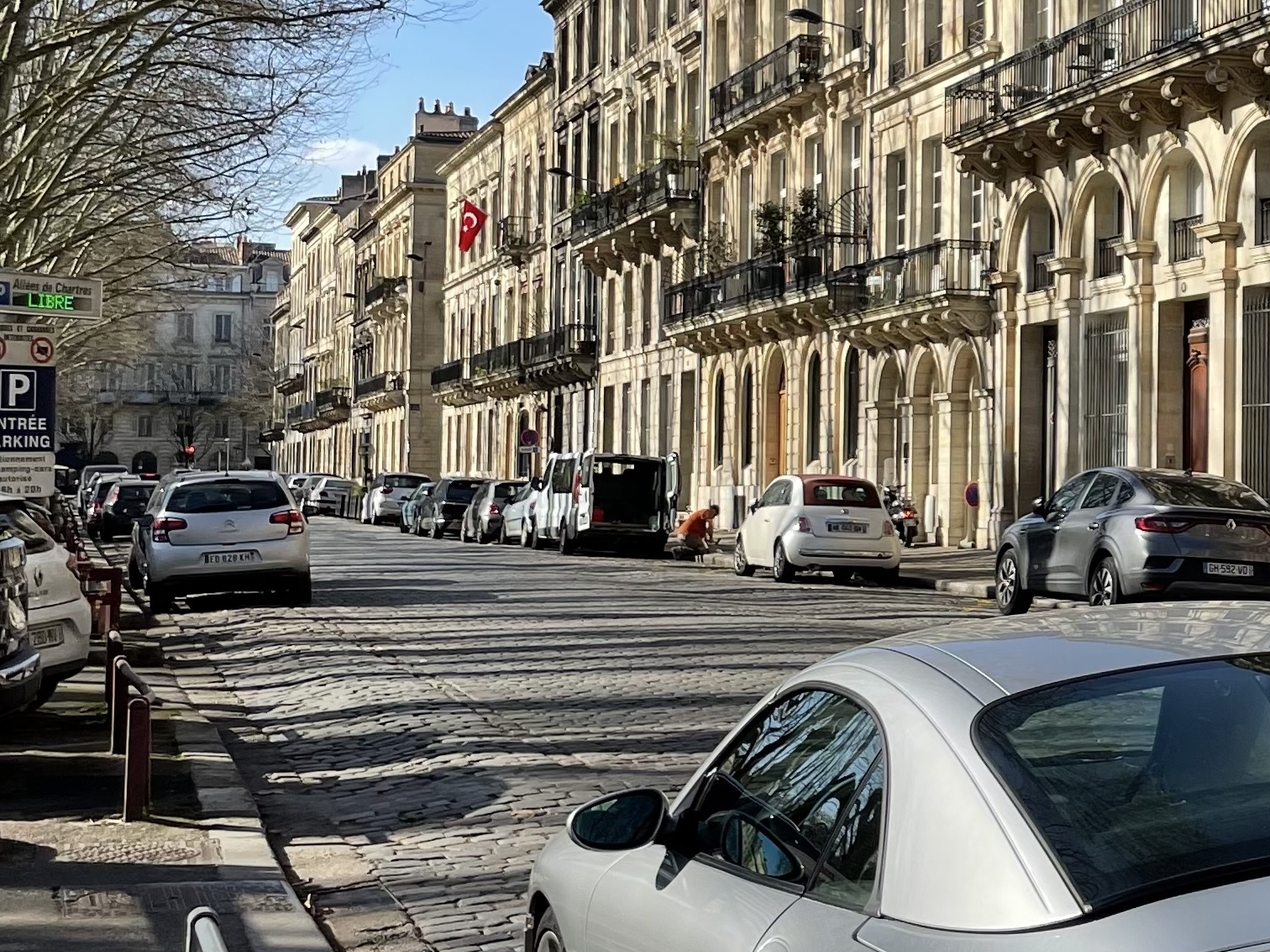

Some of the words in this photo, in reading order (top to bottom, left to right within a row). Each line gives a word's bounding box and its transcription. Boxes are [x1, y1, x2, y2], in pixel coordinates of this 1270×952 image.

[55, 282, 92, 296] Chartres
[28, 292, 74, 310] LIBRE
[9, 373, 31, 406] P
[0, 435, 51, 448] RKING
